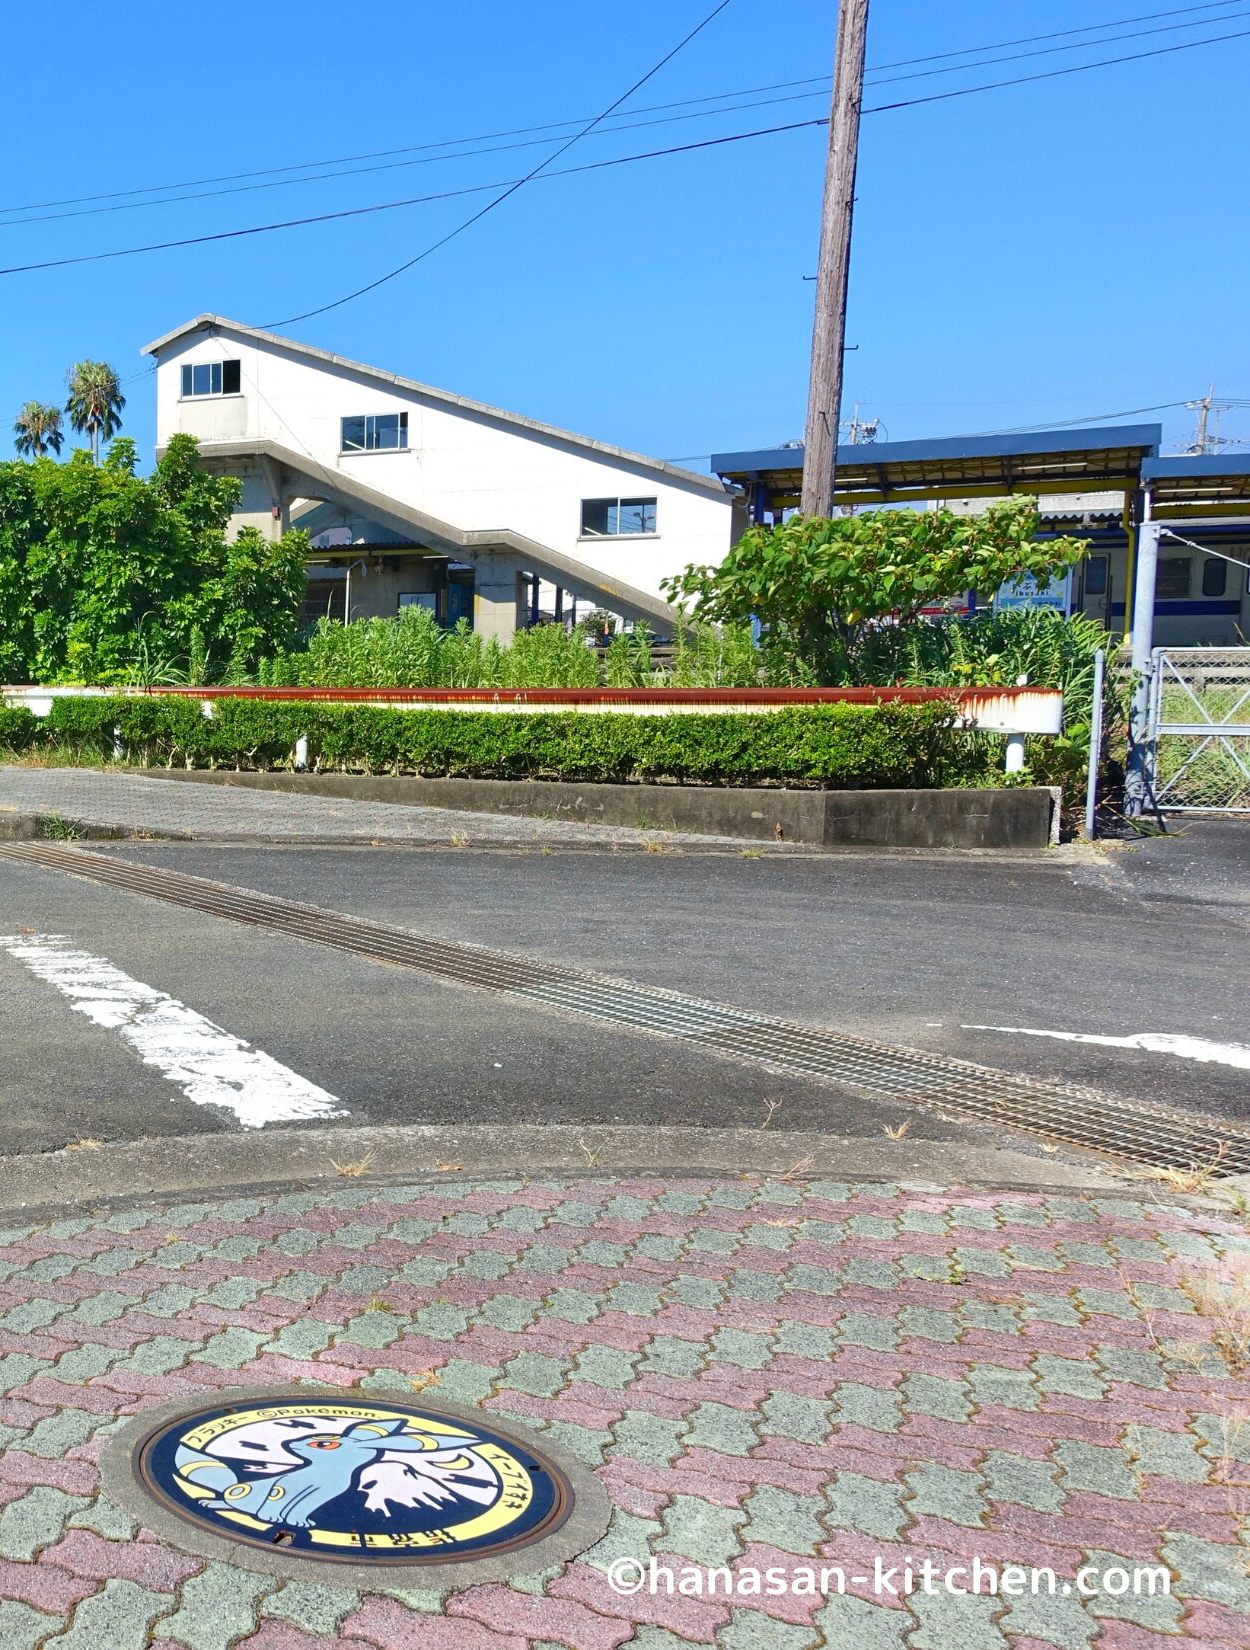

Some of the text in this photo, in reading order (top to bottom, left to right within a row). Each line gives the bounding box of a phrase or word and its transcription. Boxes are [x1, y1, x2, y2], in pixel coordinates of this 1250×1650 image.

[187, 1416, 248, 1443] ブラッキー
[489, 1453, 530, 1509] イーブイすき
